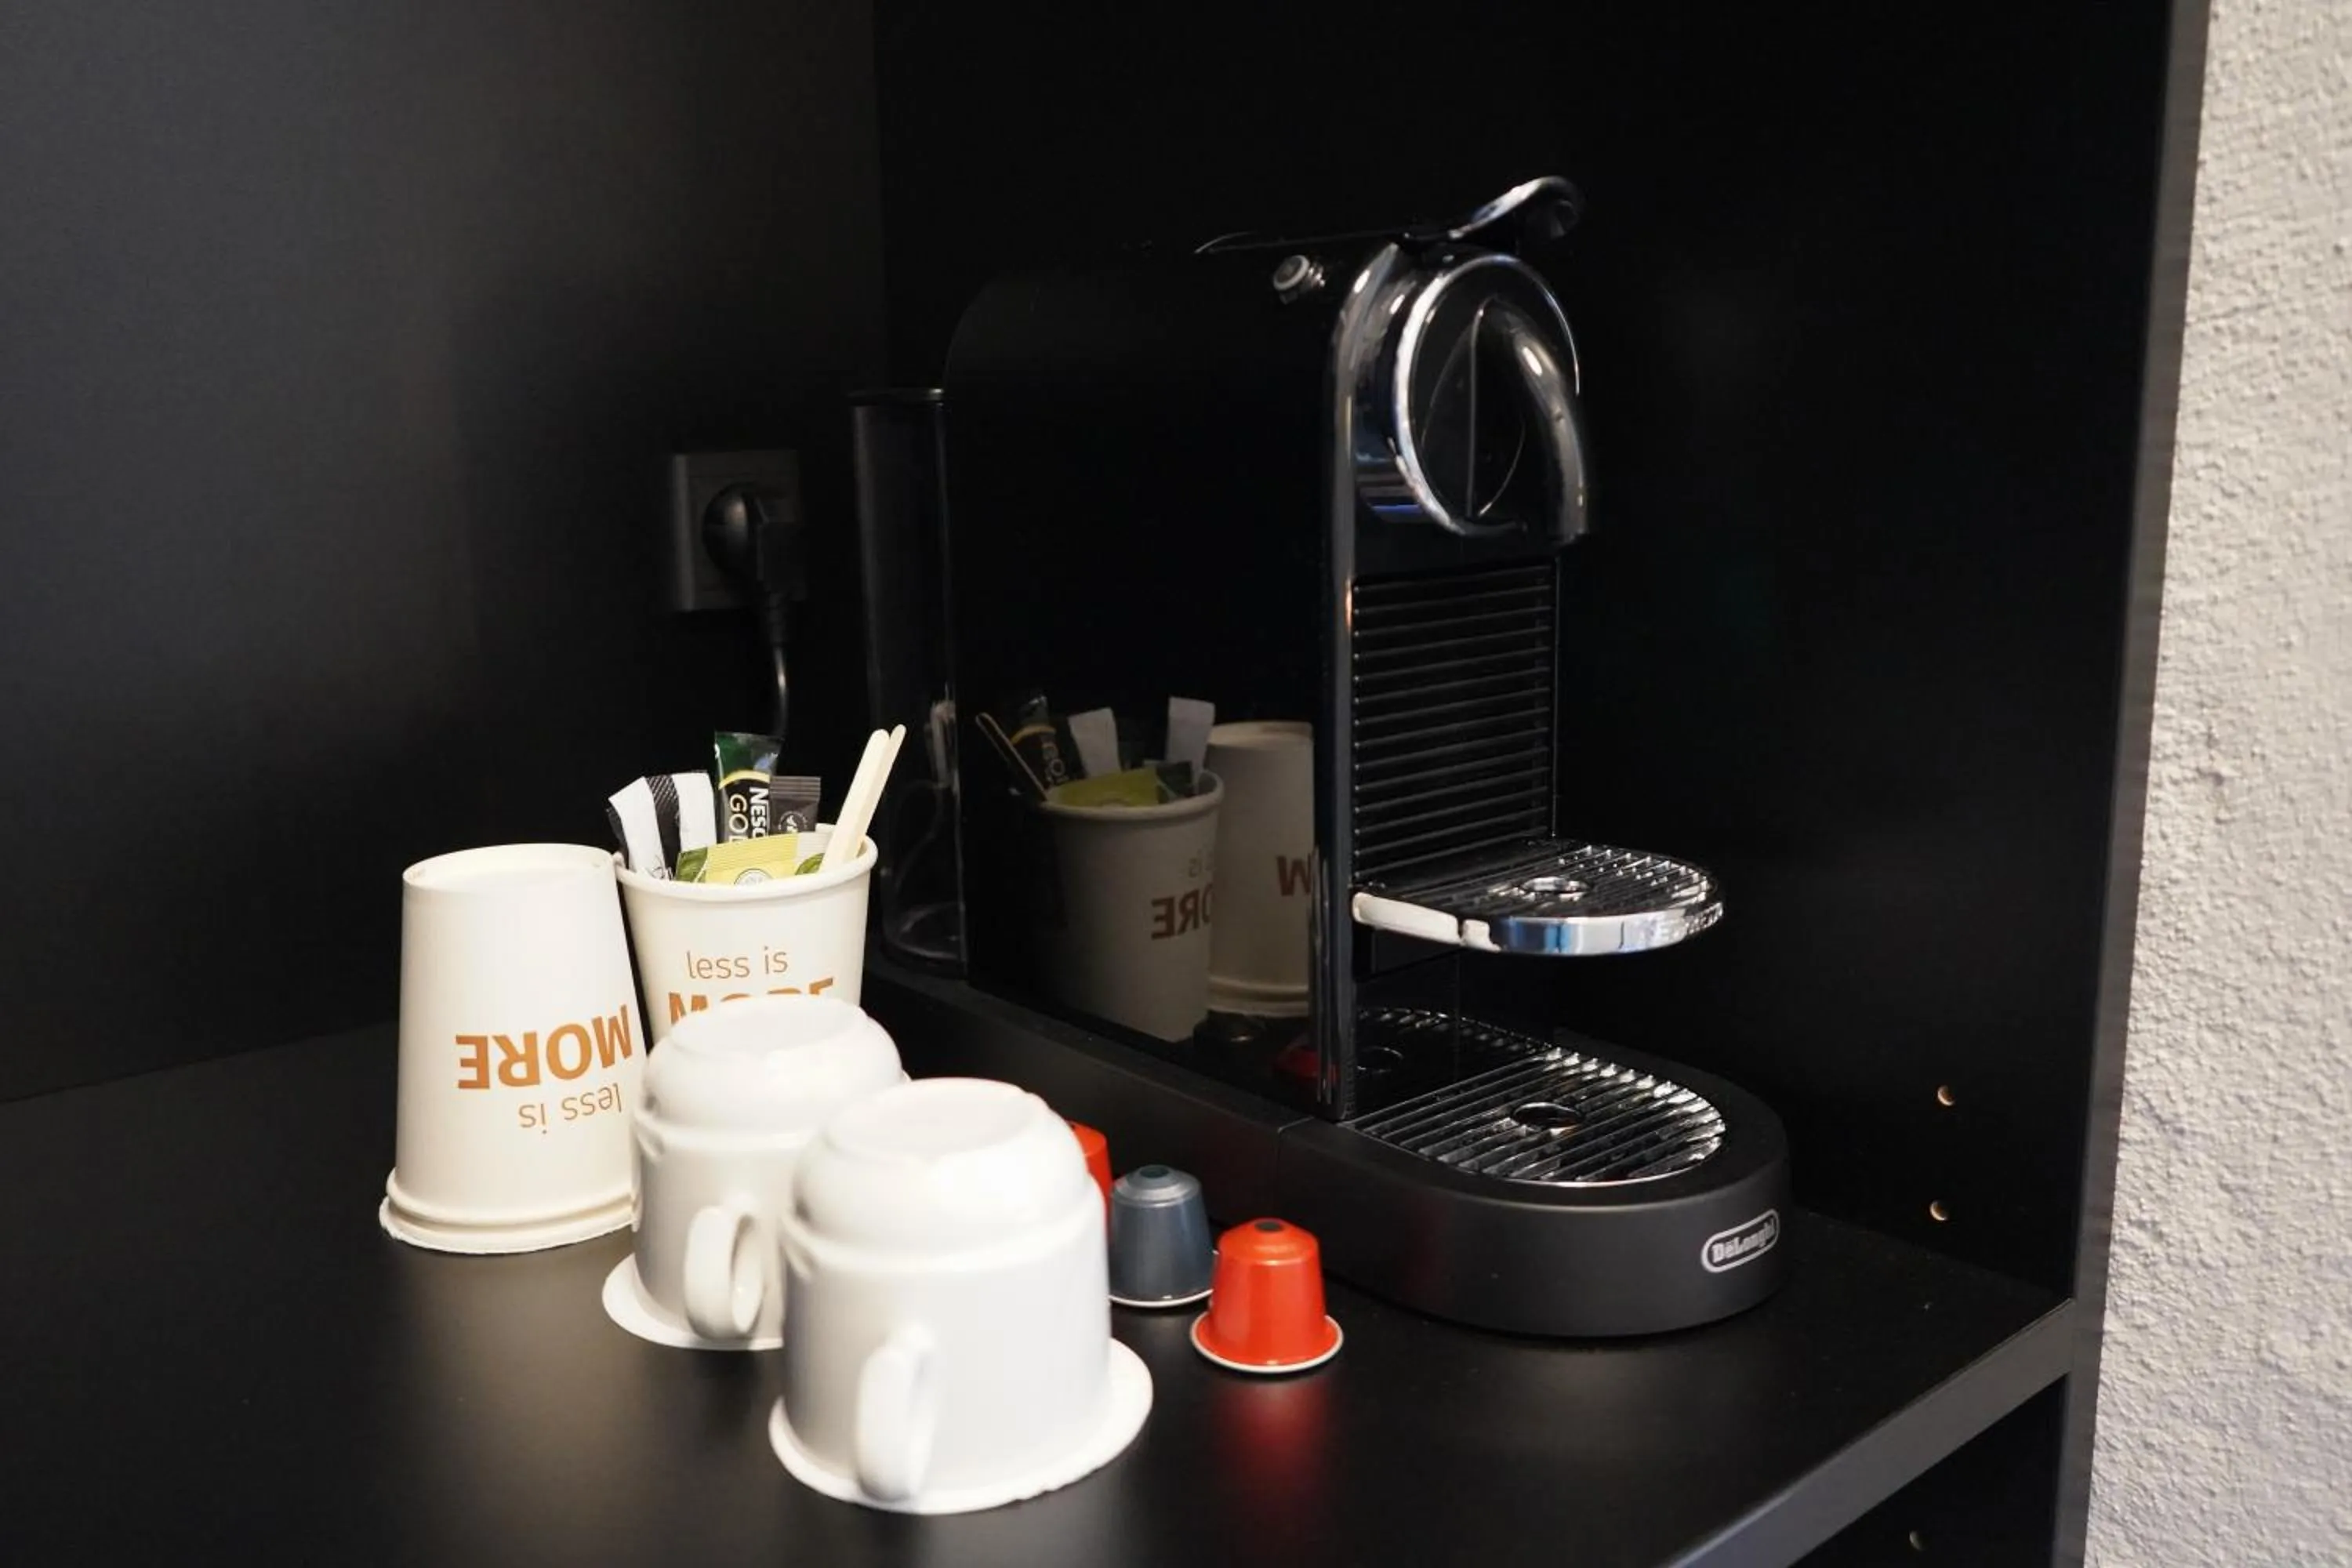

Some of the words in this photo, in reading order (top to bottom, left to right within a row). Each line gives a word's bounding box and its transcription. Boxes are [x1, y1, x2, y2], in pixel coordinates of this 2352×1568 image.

[686, 950, 750, 979] less
[764, 946, 789, 975] is
[456, 1004, 633, 1090] MORE
[518, 1104, 547, 1134] is
[561, 1083, 622, 1120] less
